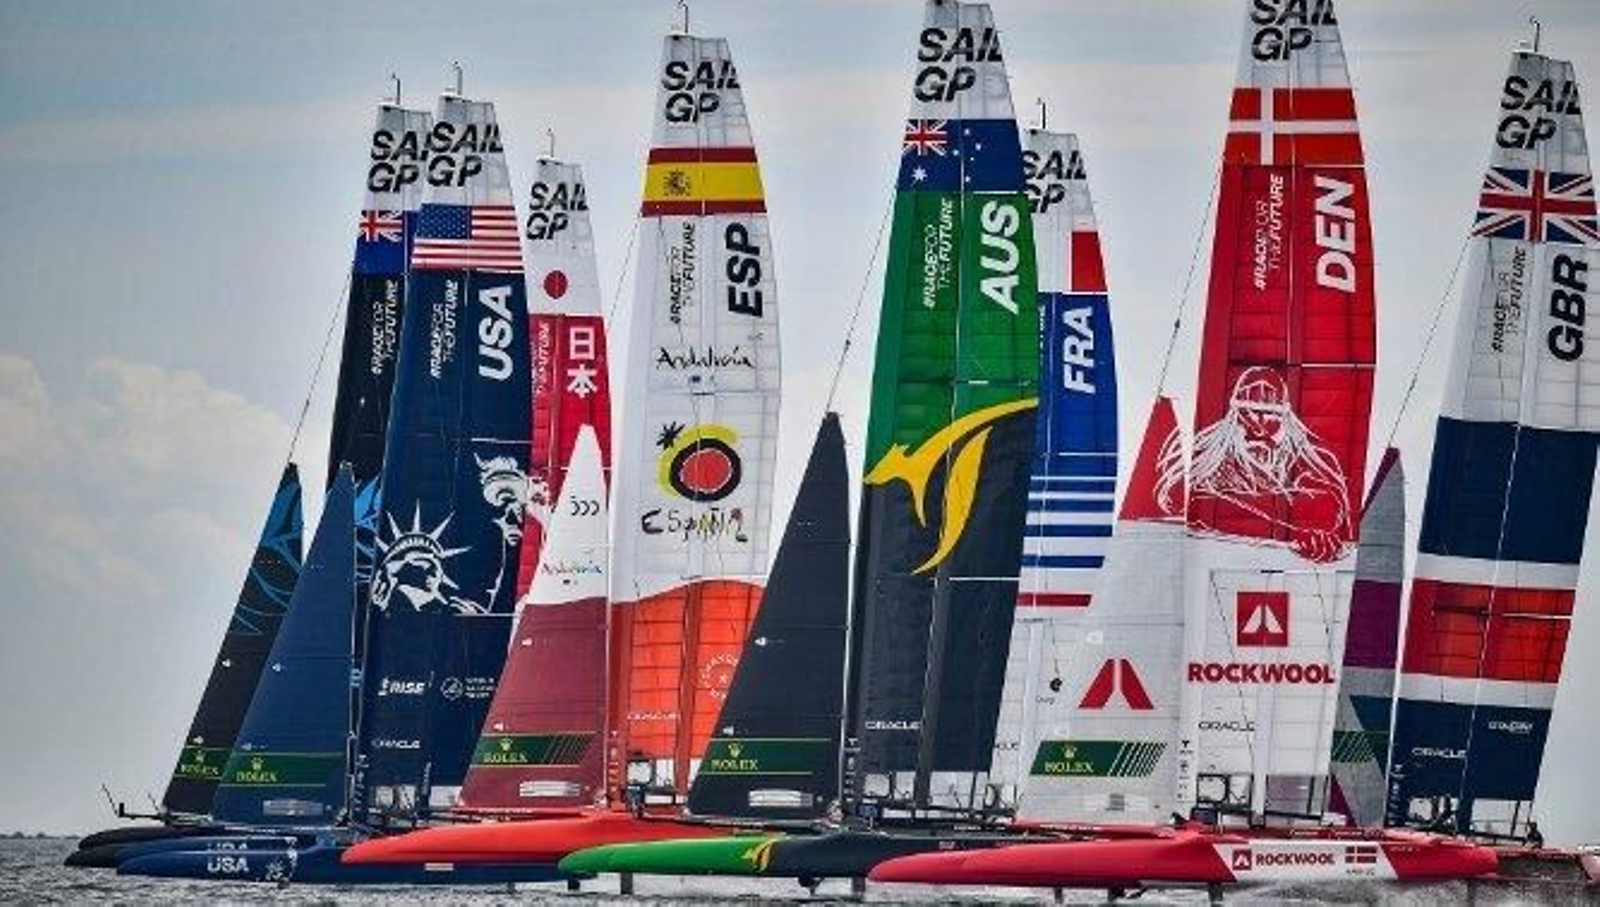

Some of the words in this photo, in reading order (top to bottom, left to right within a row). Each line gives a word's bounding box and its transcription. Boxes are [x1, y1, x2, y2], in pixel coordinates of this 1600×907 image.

[917, 27, 1003, 63] SAIL
[1251, 27, 1313, 62] GP
[661, 60, 741, 91] SAIL
[913, 66, 976, 103] GP
[664, 92, 720, 122] GP
[1501, 75, 1582, 115] SAIL
[371, 130, 433, 161] SAI
[432, 121, 504, 154] SAIL
[1495, 115, 1556, 149] GP
[367, 162, 419, 192] GP
[427, 155, 482, 187] GP
[1022, 150, 1086, 180] SAIL
[528, 181, 589, 212] SAIL
[526, 212, 568, 240] GP
[1313, 174, 1356, 294] DEN
[724, 222, 763, 319] ESP
[980, 200, 1020, 316] AUS
[1547, 253, 1588, 362] GBR
[478, 284, 513, 382] USA
[567, 327, 597, 399] 日本
[1062, 306, 1096, 395] FRA
[1188, 662, 1335, 684] ROCKWOOL
[483, 752, 528, 763] ROLEX
[711, 759, 758, 770] ROLEX
[1044, 761, 1094, 773] ROLEX
[236, 771, 278, 783] ROLEX
[207, 856, 249, 873] USA
[1255, 852, 1335, 867] ROCKWOOL
